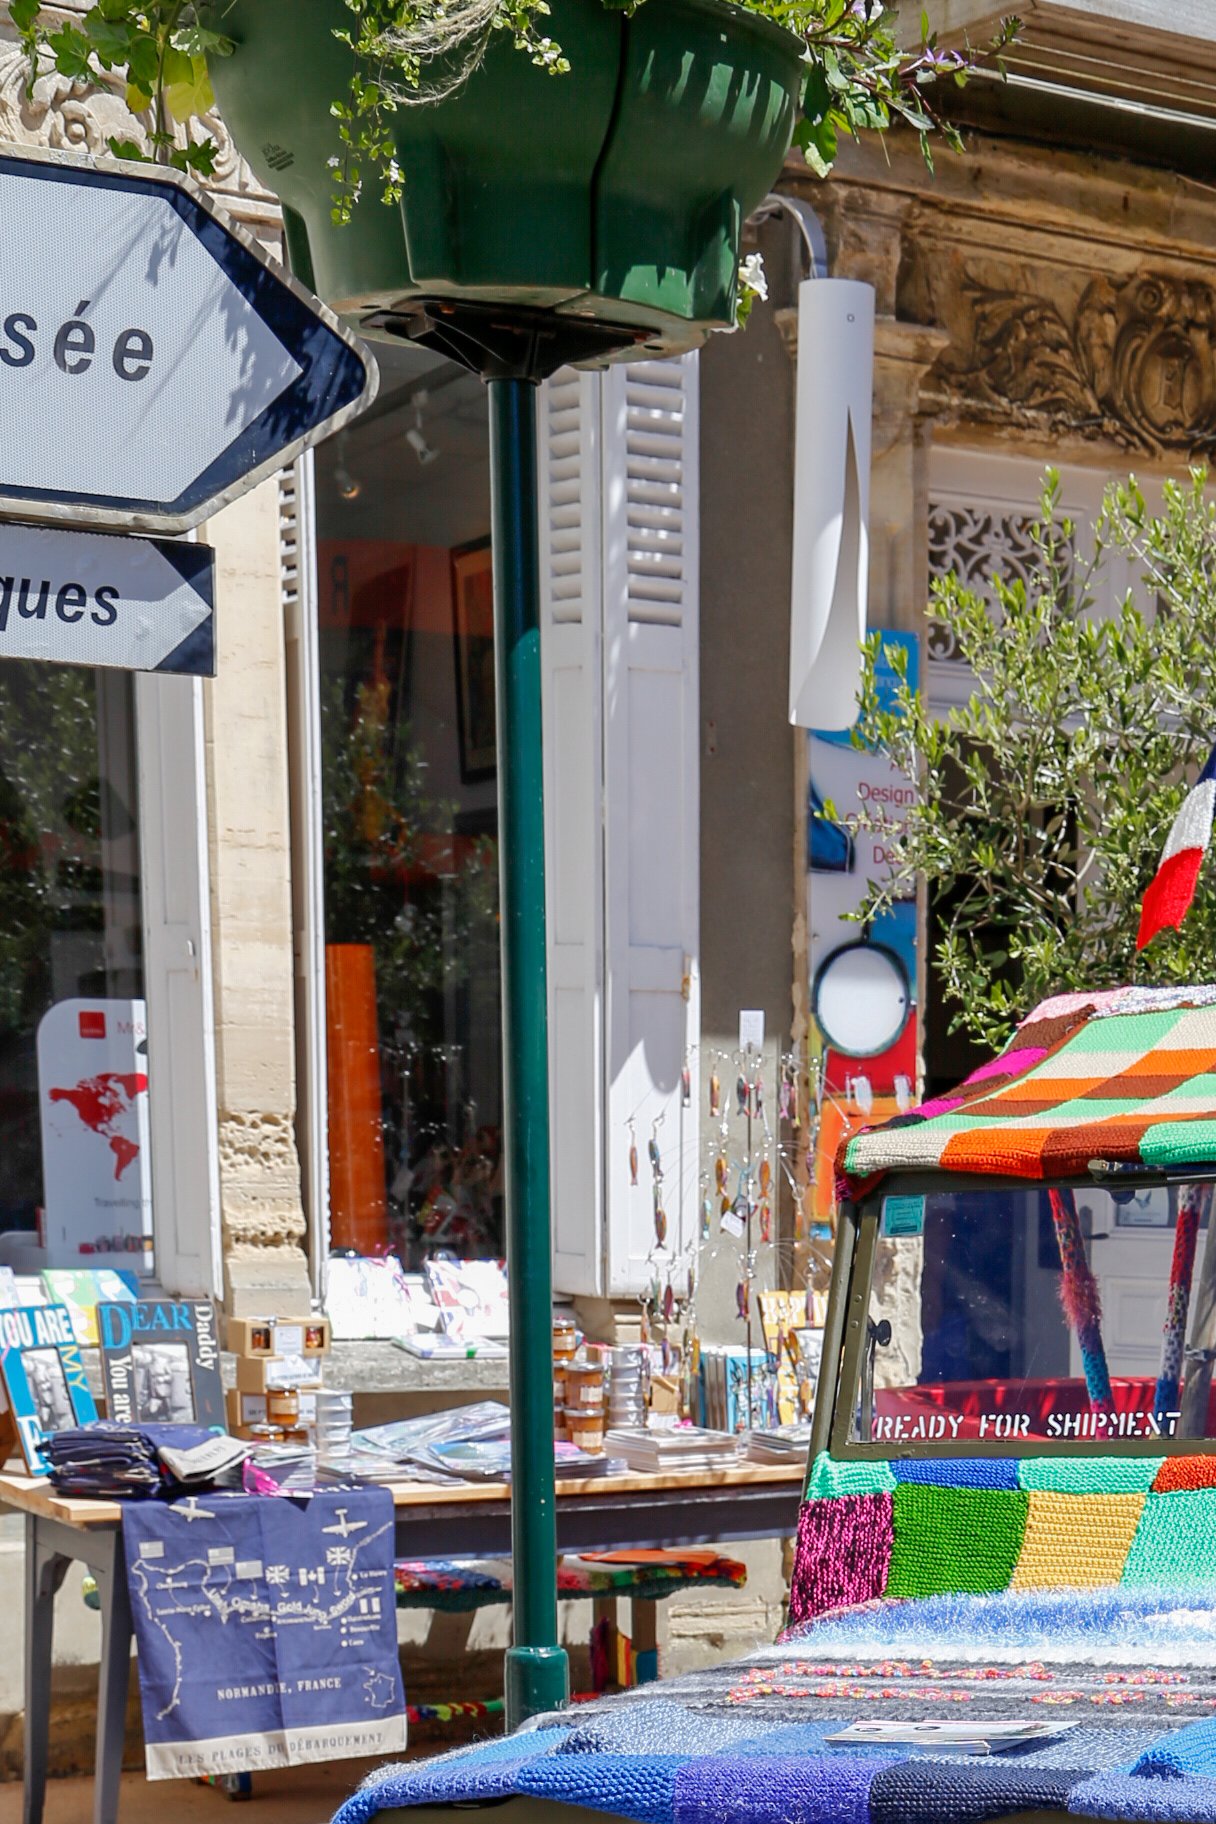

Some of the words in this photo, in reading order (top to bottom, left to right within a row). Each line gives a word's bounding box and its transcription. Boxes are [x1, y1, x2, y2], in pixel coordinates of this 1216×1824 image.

[0, 300, 153, 381] sée
[858, 782, 914, 808] Design
[33, 1306, 74, 1344] ARE
[100, 1303, 193, 1349] DEAR
[194, 1305, 218, 1371] Daddy
[58, 1346, 88, 1392] MY
[108, 1355, 132, 1390] You
[112, 1395, 132, 1424] are
[876, 1413, 965, 1440] READY
[978, 1412, 1031, 1438] FOR
[1046, 1410, 1183, 1439] SHIPMENT
[277, 1602, 302, 1614] Gold
[217, 1681, 292, 1701] NORMANDIE,
[297, 1677, 342, 1692] FRANCE
[212, 1745, 261, 1763] PLAGES
[268, 1743, 286, 1756] DU
